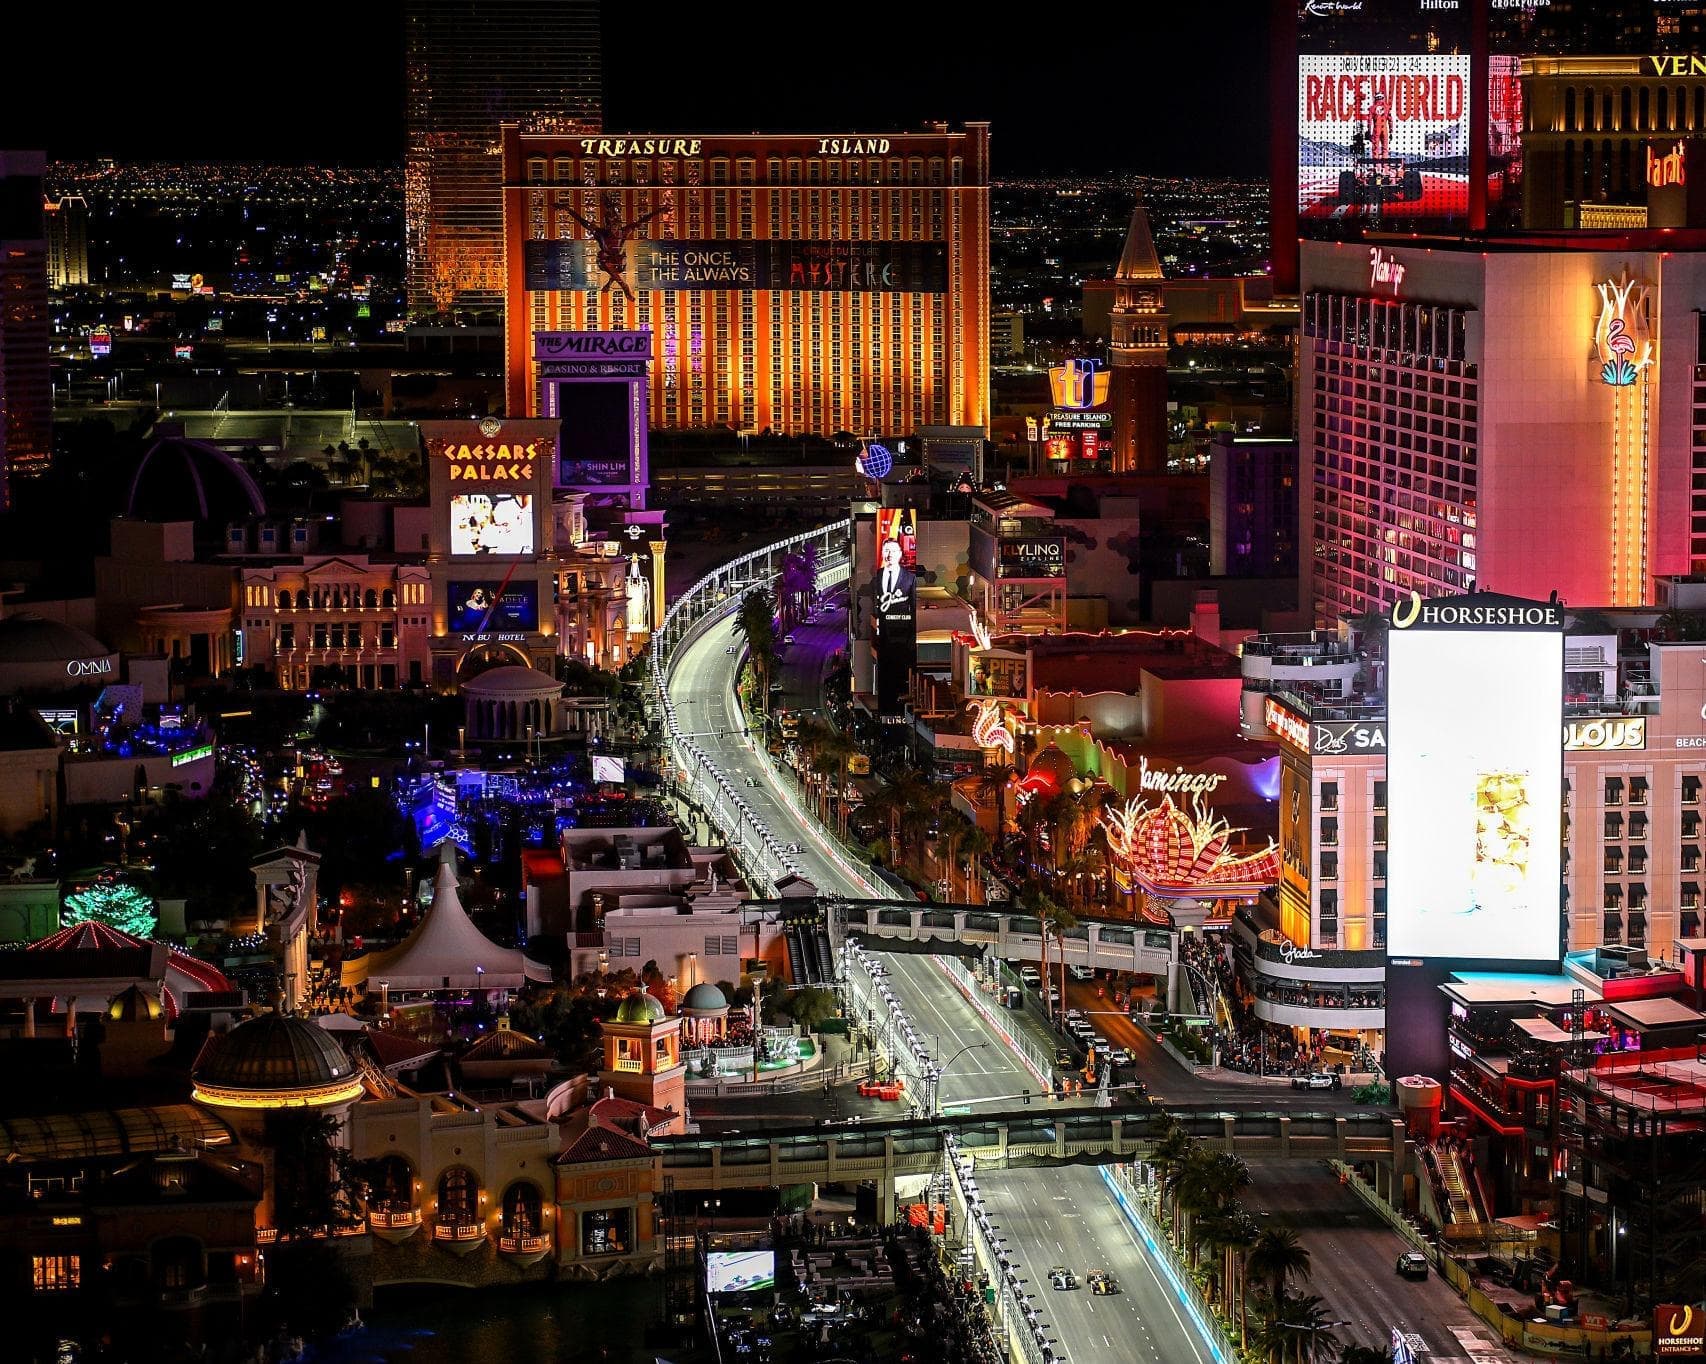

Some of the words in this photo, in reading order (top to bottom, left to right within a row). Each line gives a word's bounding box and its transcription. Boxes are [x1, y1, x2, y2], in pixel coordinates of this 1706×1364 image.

[1420, 0, 1459, 9] Hilton
[581, 139, 702, 157] TREASURE
[818, 139, 890, 154] ISLAND
[648, 252, 680, 266] THE
[684, 251, 736, 267] ONCE,
[648, 267, 680, 281] THE
[684, 267, 750, 281] ALWAYS
[1370, 247, 1405, 297] Flamingo
[538, 336, 562, 347] THE
[547, 336, 648, 355] MIRAGE
[545, 363, 588, 374] CASINO
[589, 364, 598, 374] &
[600, 363, 641, 374] RESORT
[444, 444, 537, 460] CAESARS
[450, 464, 533, 480] PALACE
[587, 462, 609, 471] SHIN
[610, 462, 626, 471] LIM
[1003, 544, 1060, 556] FLYLINQ
[500, 596, 529, 604] ADELE
[67, 659, 112, 677] OMNIA
[1140, 755, 1228, 806] lamingo
[1280, 939, 1323, 964] Giada
[1658, 1337, 1704, 1346] HORSESHOE
